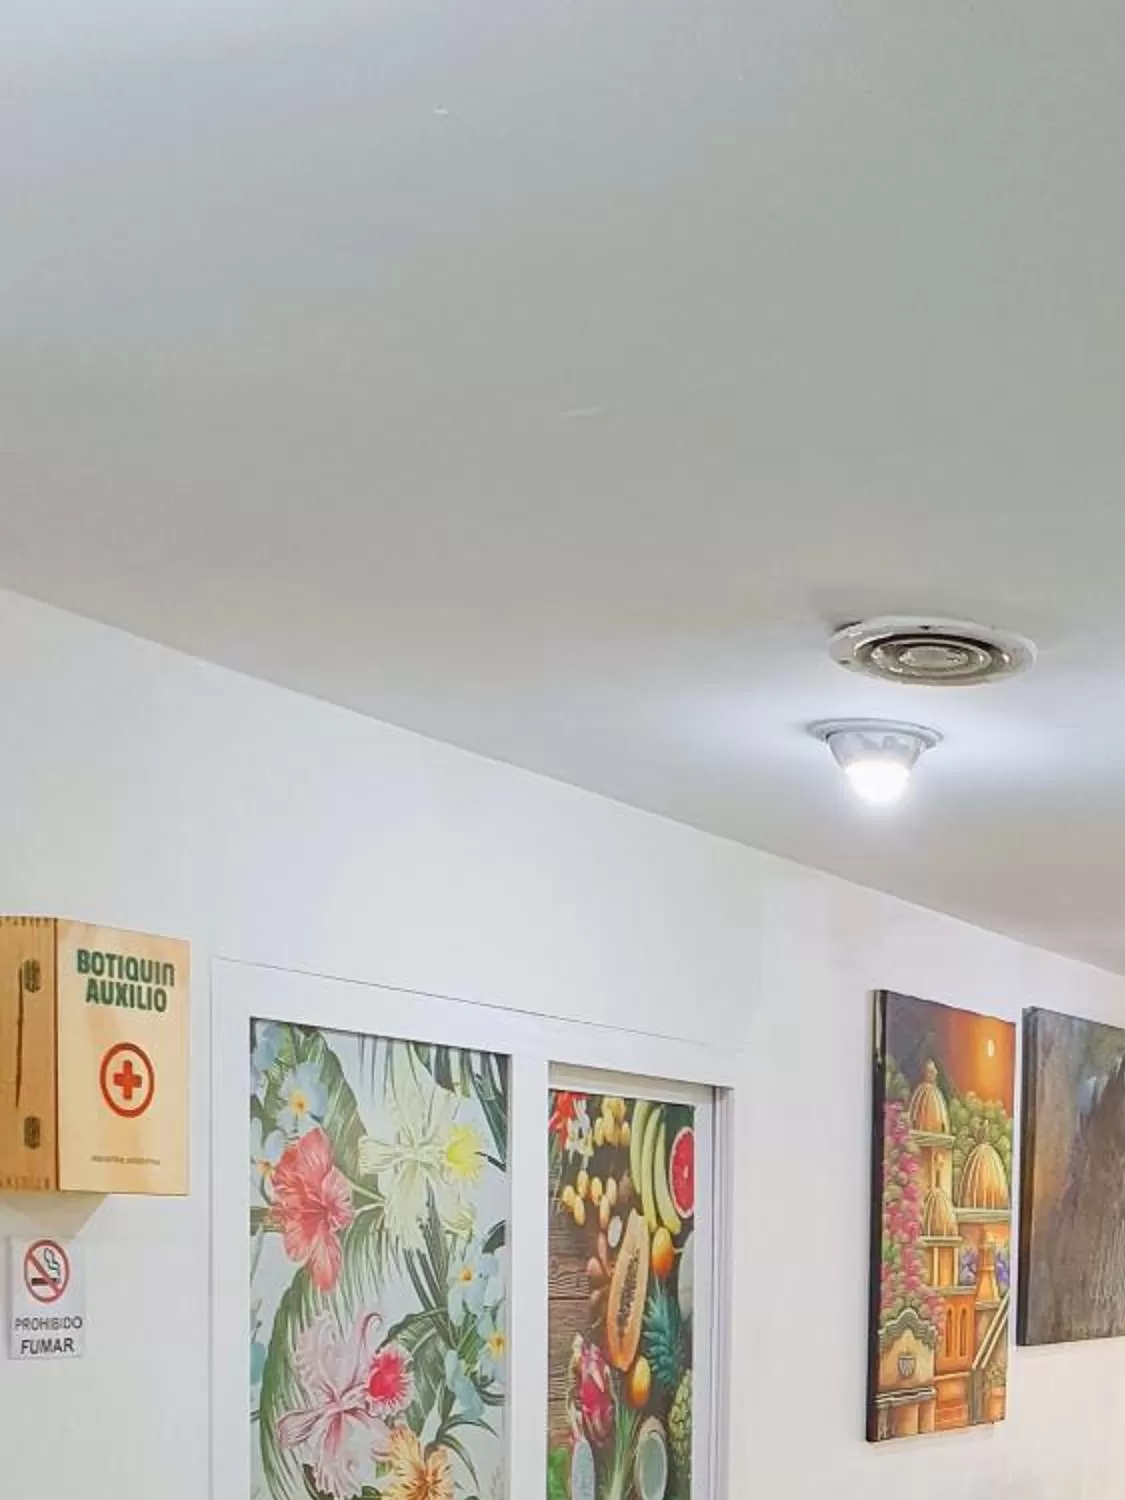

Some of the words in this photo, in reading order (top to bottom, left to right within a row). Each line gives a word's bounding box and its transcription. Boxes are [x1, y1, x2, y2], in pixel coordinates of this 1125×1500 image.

[85, 978, 167, 1012] AUXILIO
[14, 1316, 84, 1331] PROHIBIDO
[20, 1338, 75, 1355] FUMAR
